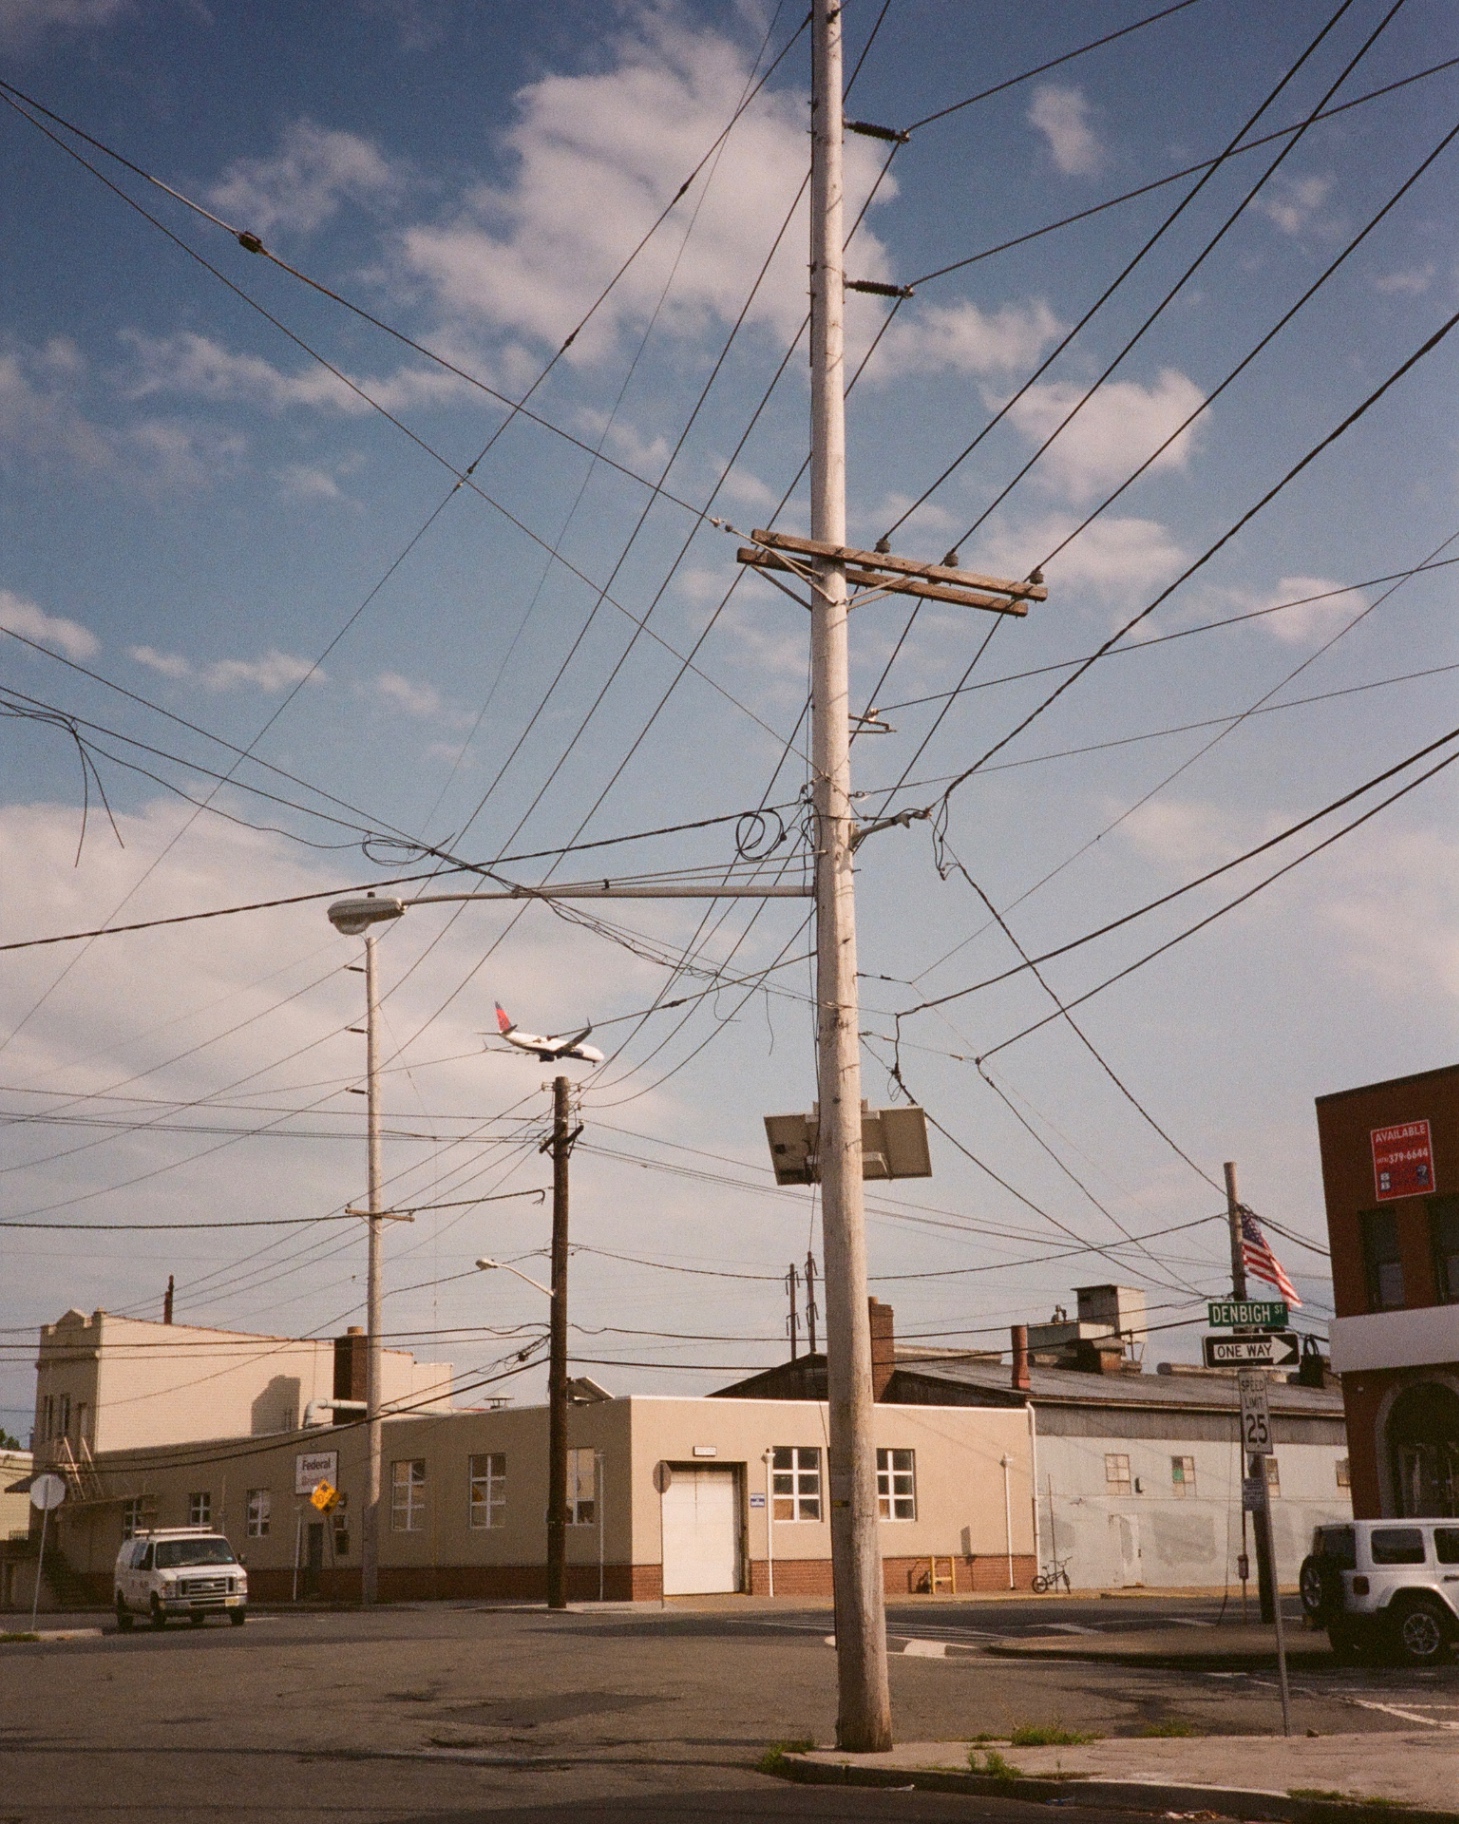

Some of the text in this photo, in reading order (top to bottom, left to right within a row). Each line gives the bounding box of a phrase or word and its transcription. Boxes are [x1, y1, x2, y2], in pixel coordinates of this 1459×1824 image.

[1375, 1124, 1426, 1142] AVAILABLE
[1212, 1305, 1284, 1323] DENBIGH ST
[1217, 1344, 1272, 1358] ONE WAY
[1241, 1379, 1265, 1392] SPEED
[1244, 1396, 1264, 1409] LIMIT
[1246, 1413, 1268, 1444] 25
[302, 1457, 331, 1470] Federal
